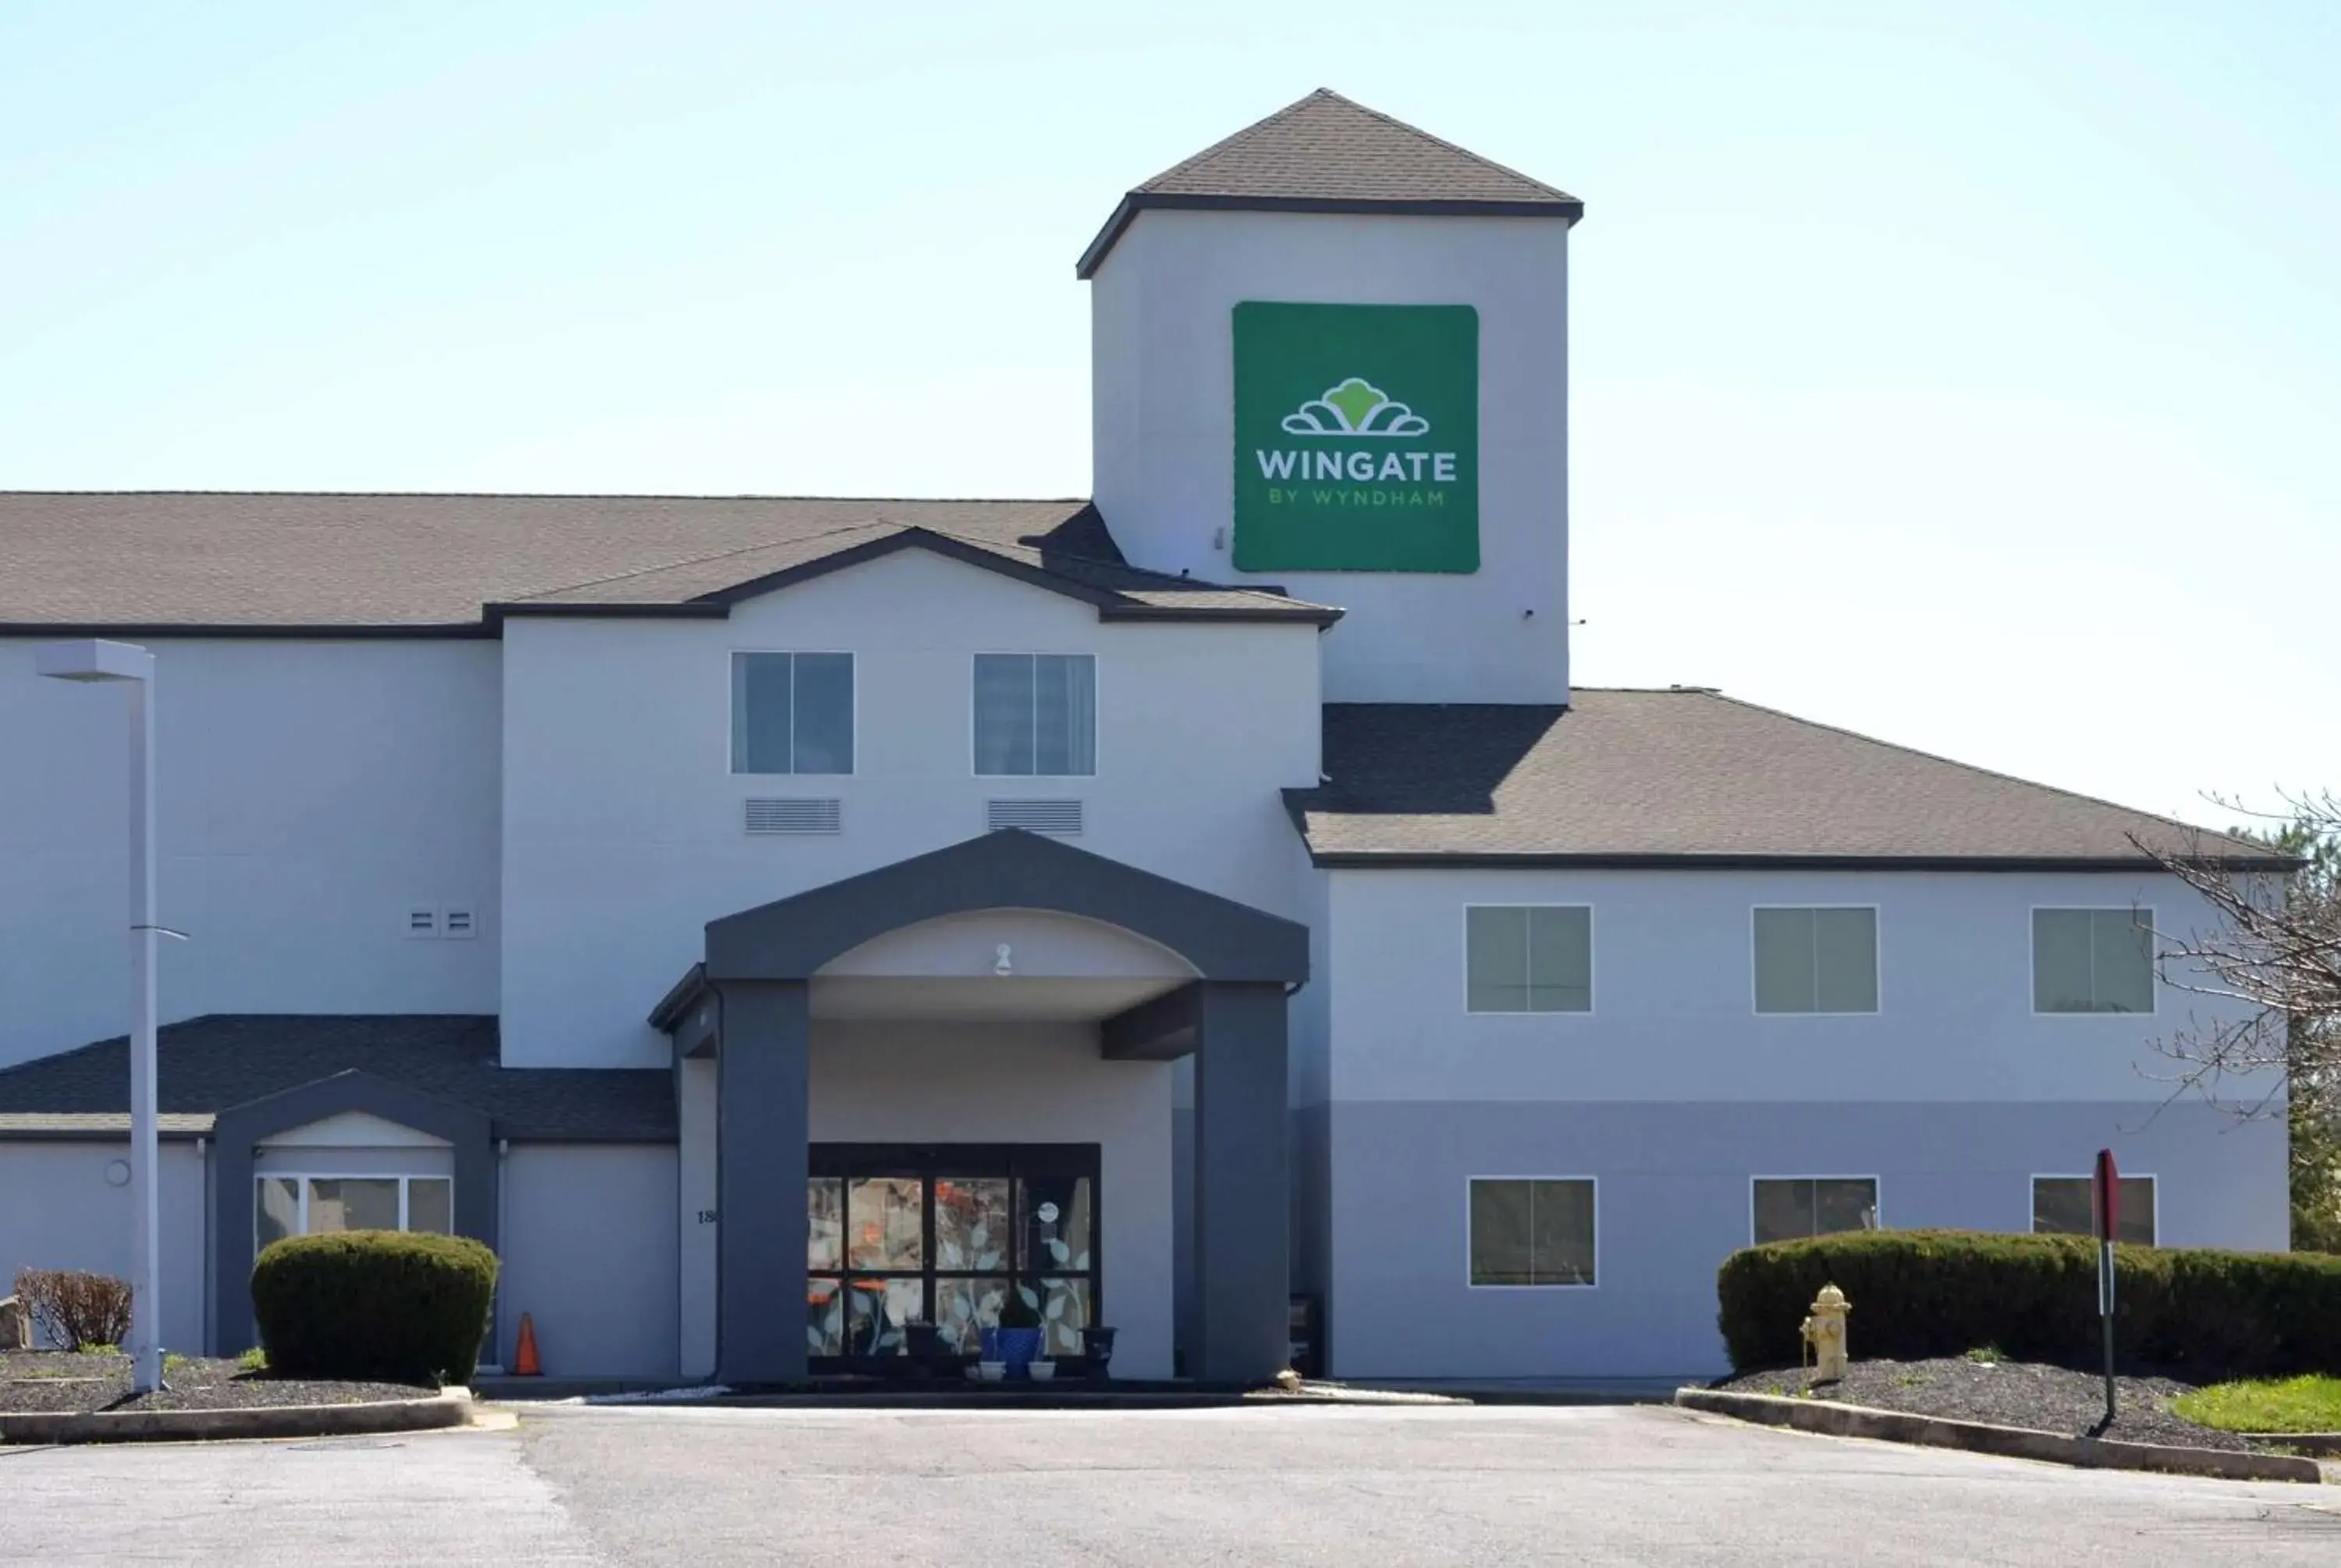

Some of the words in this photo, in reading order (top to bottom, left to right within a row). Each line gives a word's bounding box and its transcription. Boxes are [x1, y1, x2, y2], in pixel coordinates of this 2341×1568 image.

[1256, 449, 1458, 482] WINGATE
[1269, 488, 1298, 504] BY
[1313, 488, 1444, 506] WYNDHAM
[698, 1209, 717, 1224] 18
